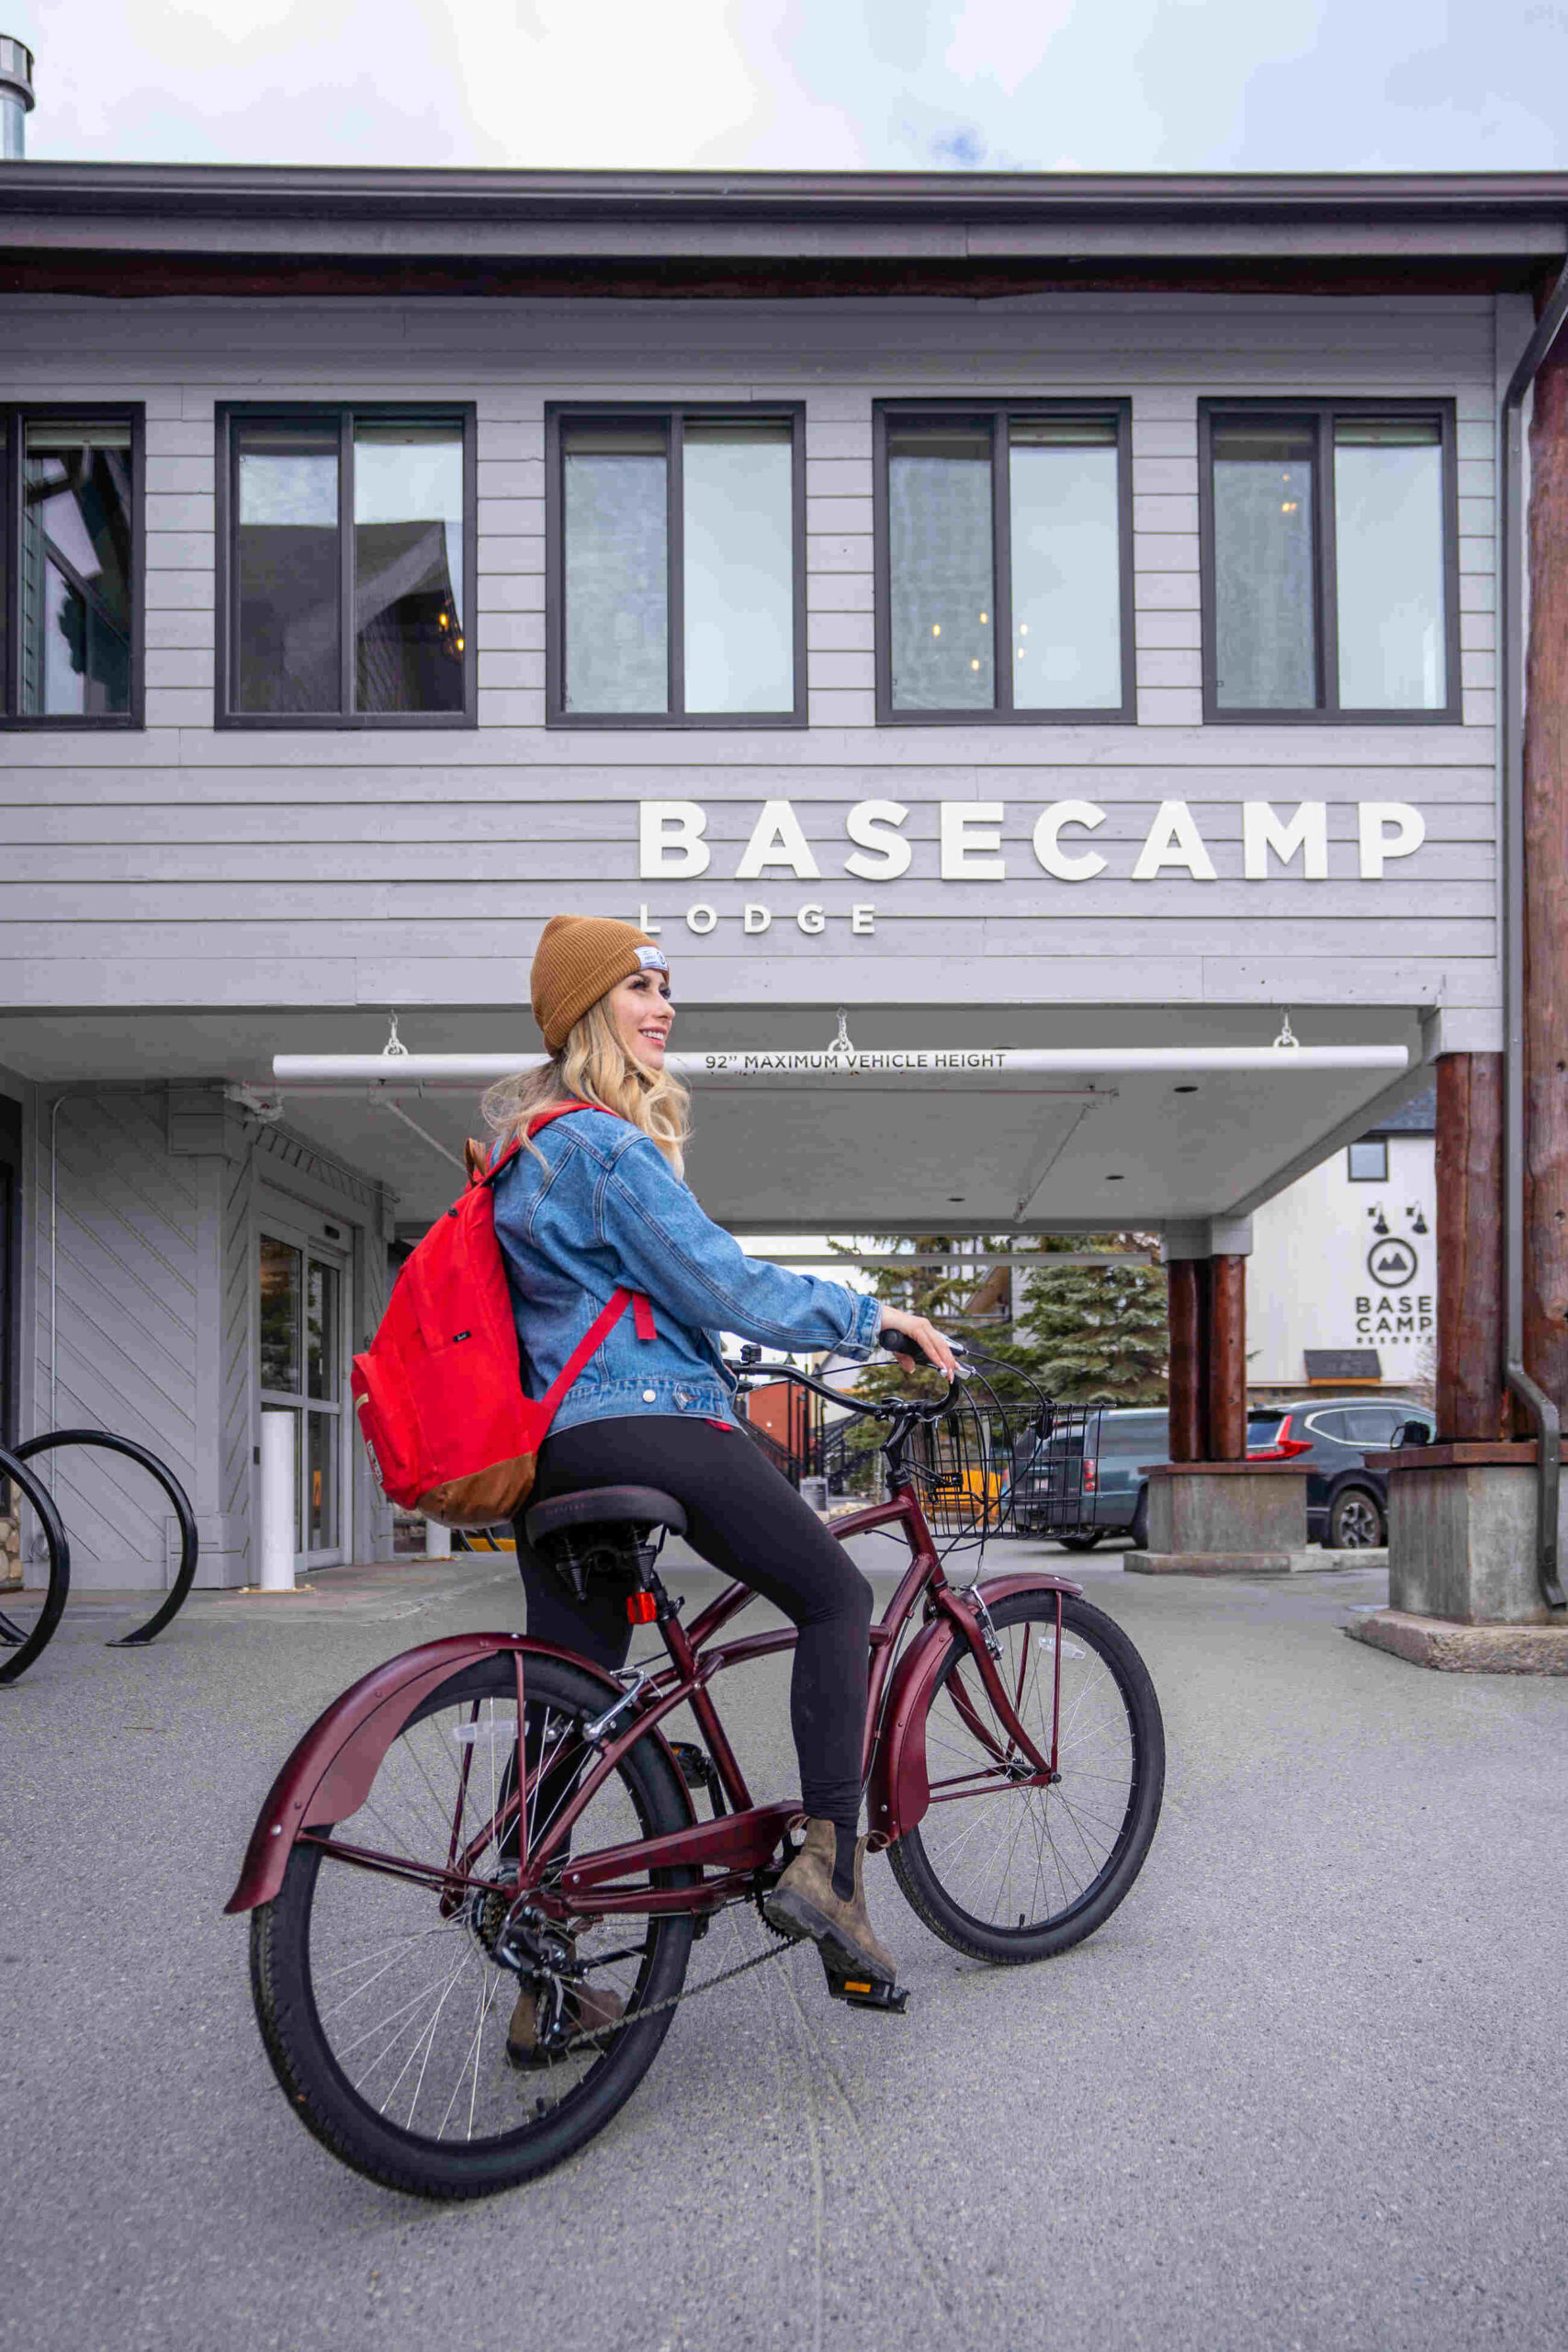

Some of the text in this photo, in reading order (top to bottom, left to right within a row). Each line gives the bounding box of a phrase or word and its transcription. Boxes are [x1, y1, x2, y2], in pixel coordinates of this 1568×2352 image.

[639, 800, 1427, 881] BASECAMP
[639, 903, 876, 934] LODGE
[744, 1055, 839, 1069] MAXIMUM
[845, 1054, 929, 1069] VEHICLE
[934, 1053, 1008, 1069] HEIGHT
[1356, 1296, 1433, 1314] BASE
[1357, 1317, 1433, 1333] CAMP
